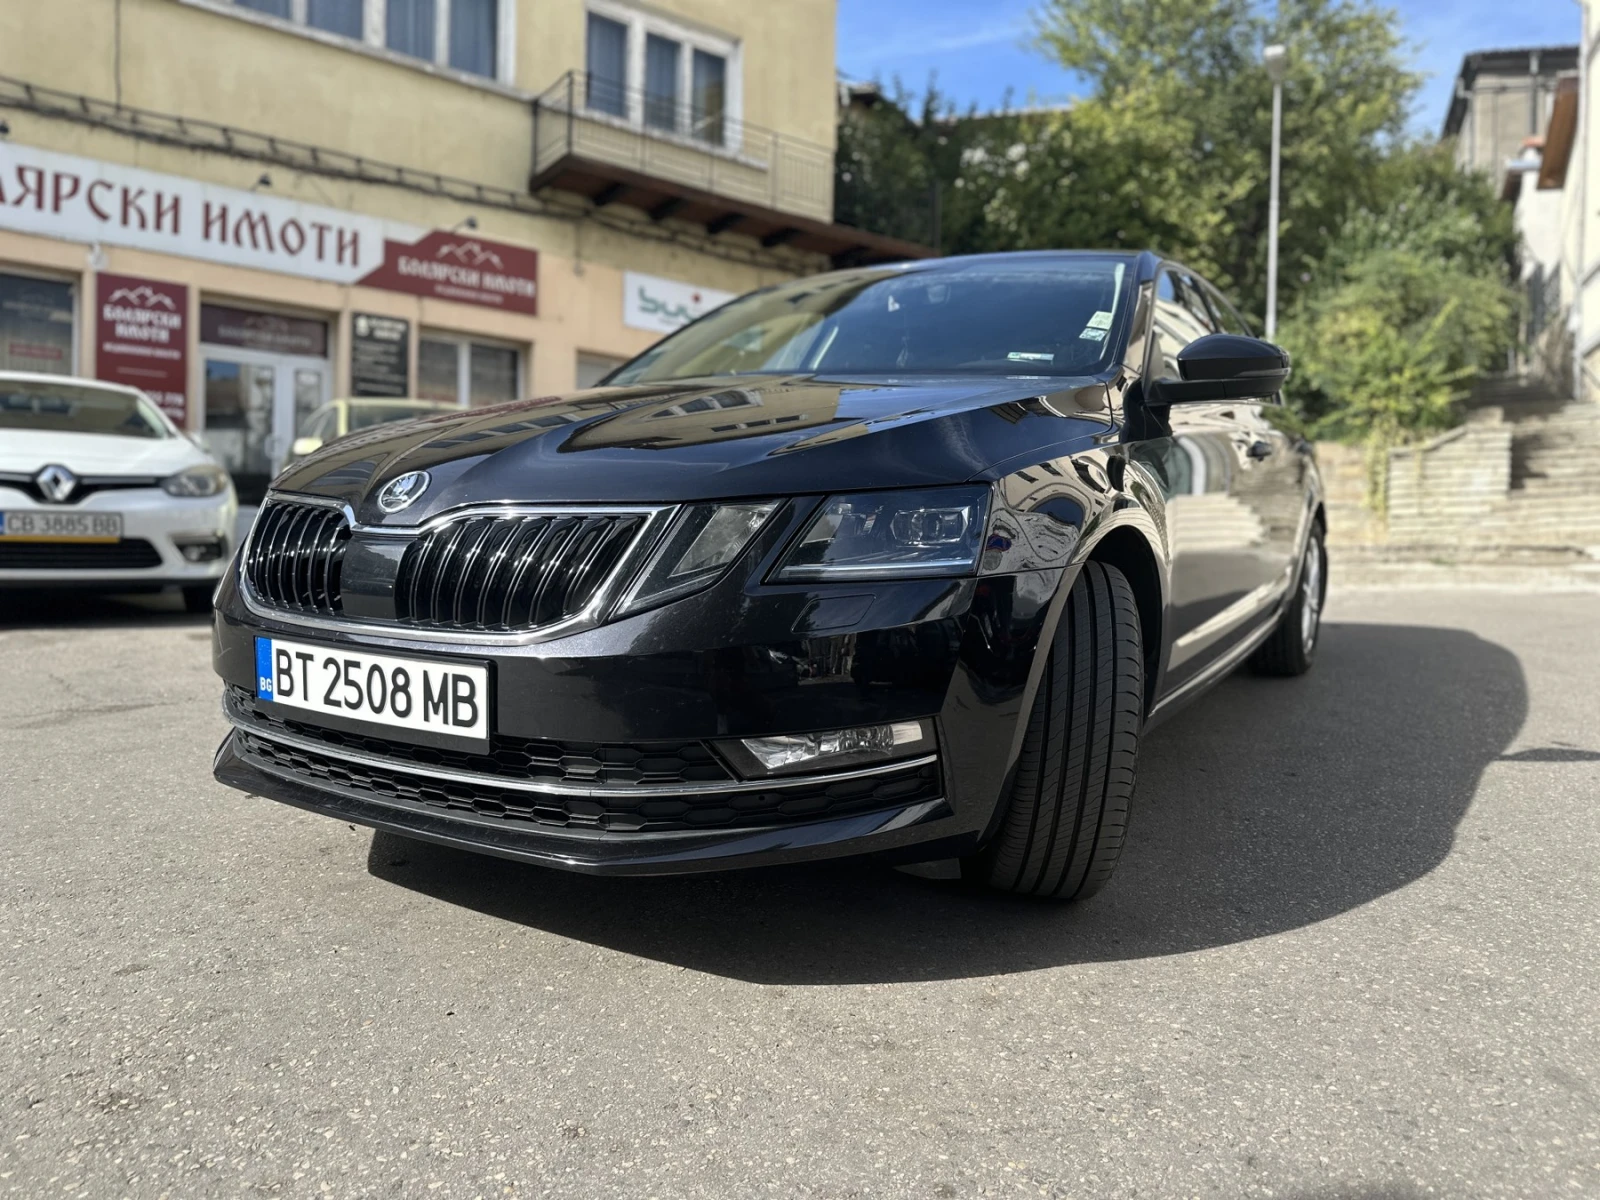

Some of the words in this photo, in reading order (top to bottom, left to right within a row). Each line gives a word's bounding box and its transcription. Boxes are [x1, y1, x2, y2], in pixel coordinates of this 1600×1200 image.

[202, 200, 361, 268] ИМОТИ
[260, 676, 272, 692] BG
[276, 648, 314, 702] BT
[322, 656, 412, 718] 2508
[423, 669, 478, 728] MB
